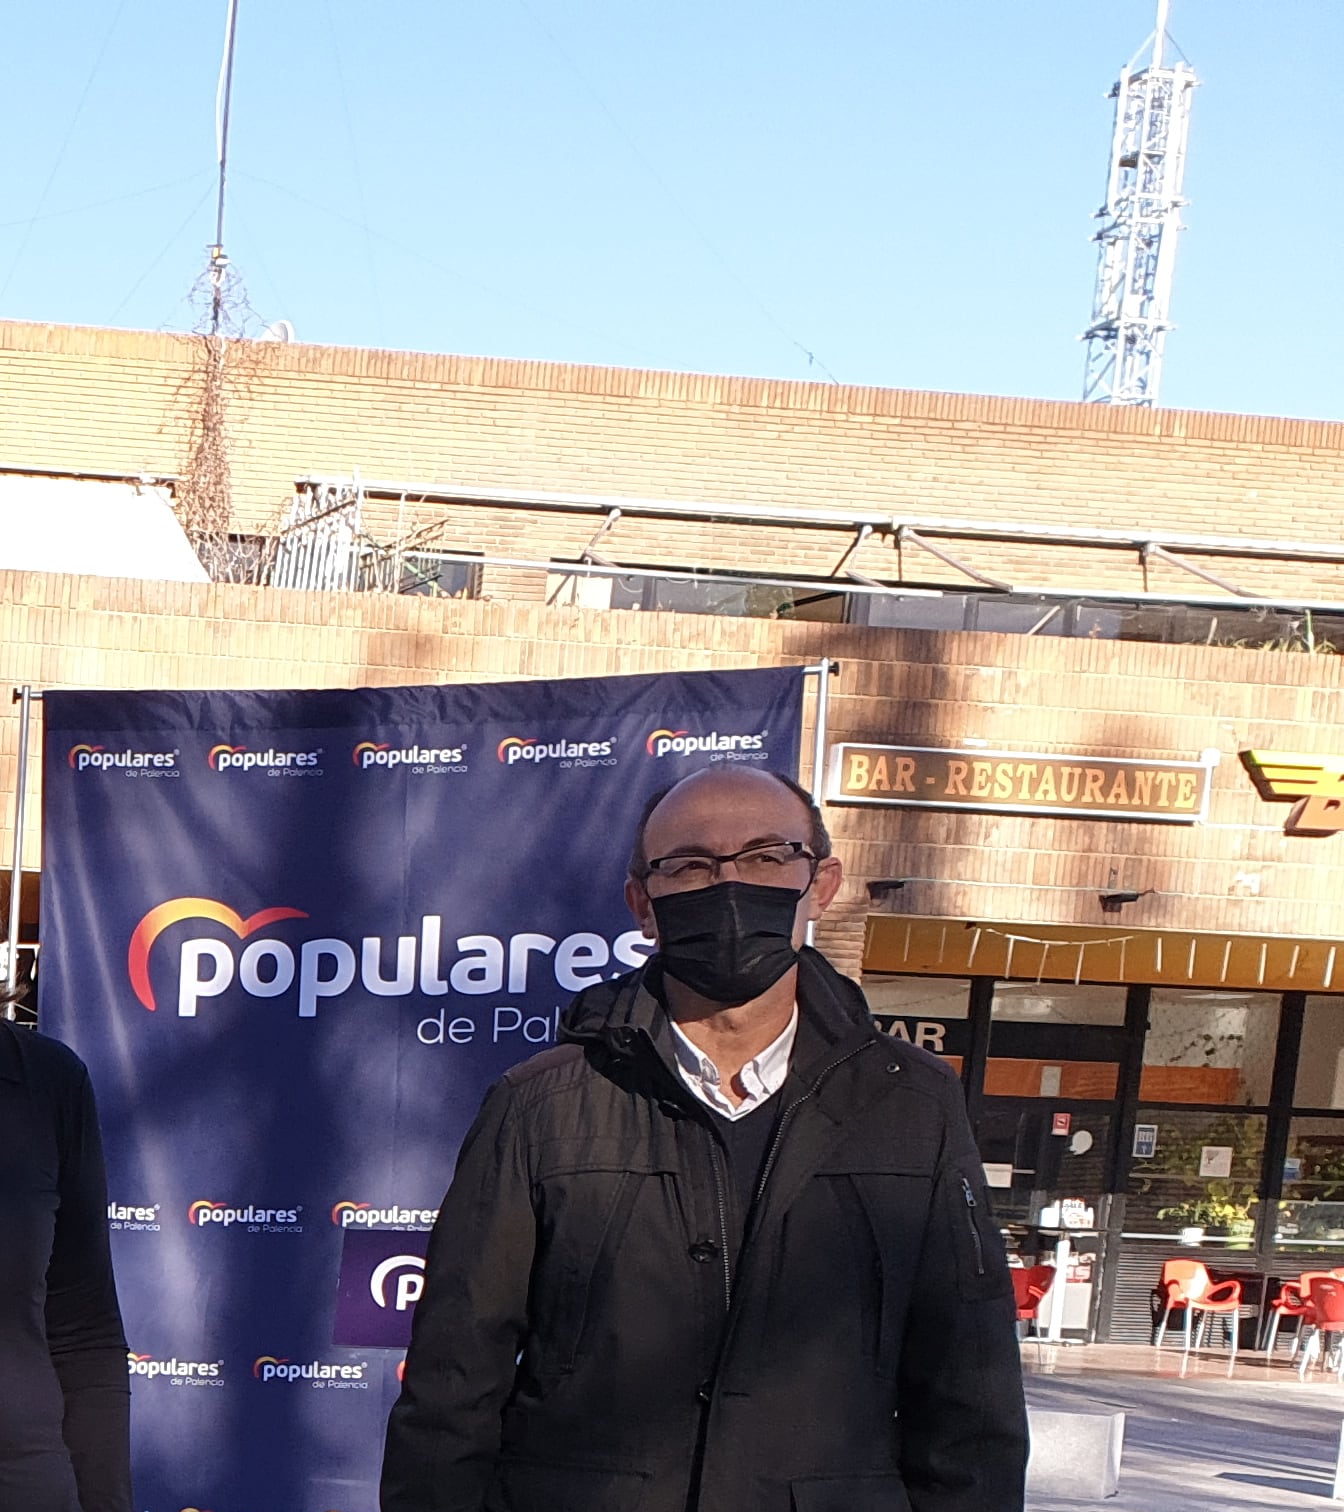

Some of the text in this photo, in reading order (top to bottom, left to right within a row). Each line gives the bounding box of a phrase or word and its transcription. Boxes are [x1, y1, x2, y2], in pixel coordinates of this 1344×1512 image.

[507, 739, 611, 765] populares
[656, 731, 763, 757] populares
[78, 748, 175, 771] populares
[218, 748, 318, 772] populares
[362, 745, 463, 769] populares
[559, 757, 618, 769] de Palencia
[709, 751, 769, 762] de Palencia
[124, 769, 180, 778] de Palencia
[267, 767, 324, 777] de Palencia
[411, 764, 468, 774] de Palencia
[846, 754, 916, 792] BAR
[944, 759, 1198, 809] RESTAURANTE
[178, 914, 657, 1017] populares
[416, 1007, 476, 1044] de
[874, 1020, 946, 1052] AR
[107, 1203, 155, 1221] lares
[198, 1204, 298, 1228] populares
[123, 1221, 161, 1232] Palencia
[247, 1223, 303, 1233] de Palencia
[170, 1376, 225, 1388] de Palencia
[262, 1360, 363, 1382] populares
[311, 1379, 369, 1390] de Palencia
